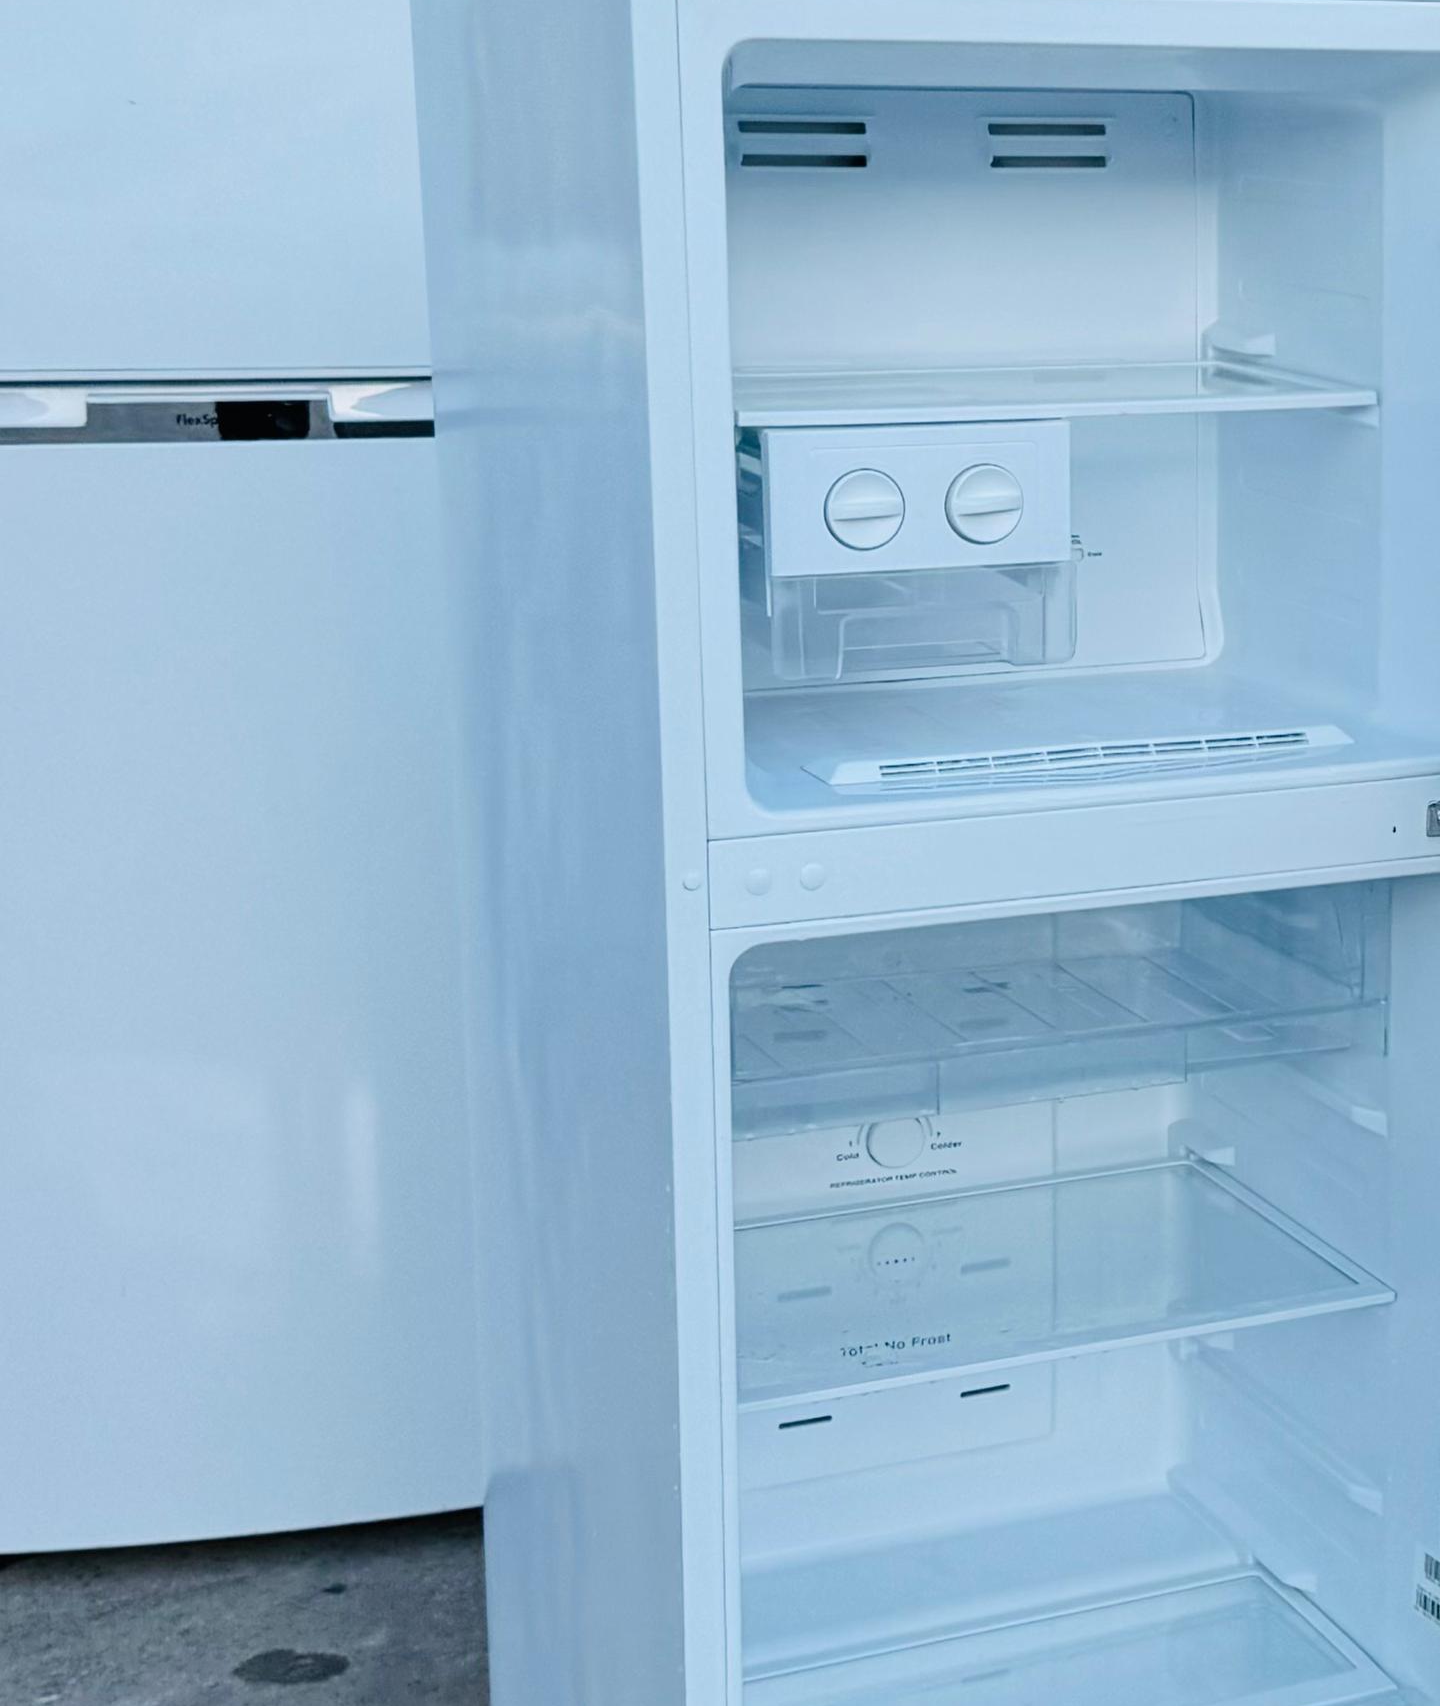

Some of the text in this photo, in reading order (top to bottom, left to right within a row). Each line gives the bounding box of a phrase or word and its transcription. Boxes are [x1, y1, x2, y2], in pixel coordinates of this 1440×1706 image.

[930, 1141, 962, 1151] Colder
[836, 1153, 860, 1162] Cold
[911, 1333, 951, 1348] Frost
